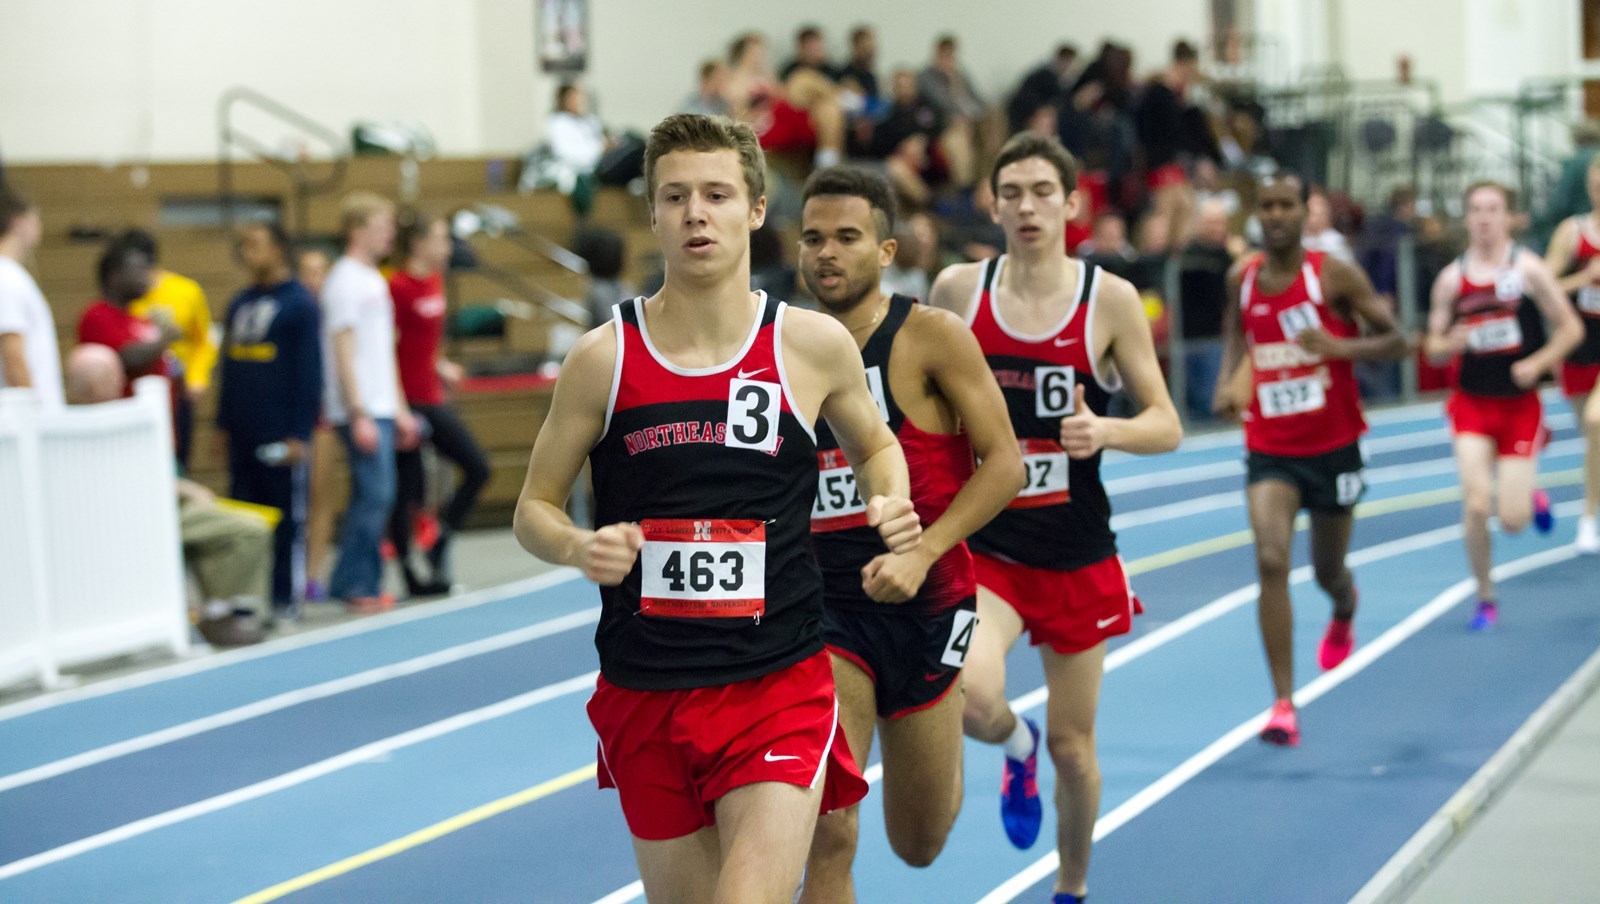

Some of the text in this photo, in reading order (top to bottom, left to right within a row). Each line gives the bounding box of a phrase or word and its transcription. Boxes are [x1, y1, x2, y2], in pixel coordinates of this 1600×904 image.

[1042, 371, 1069, 412] 6
[732, 384, 770, 444] 3
[623, 421, 784, 457] NORTHEASN
[661, 550, 744, 592] 463
[950, 616, 980, 663] 4
